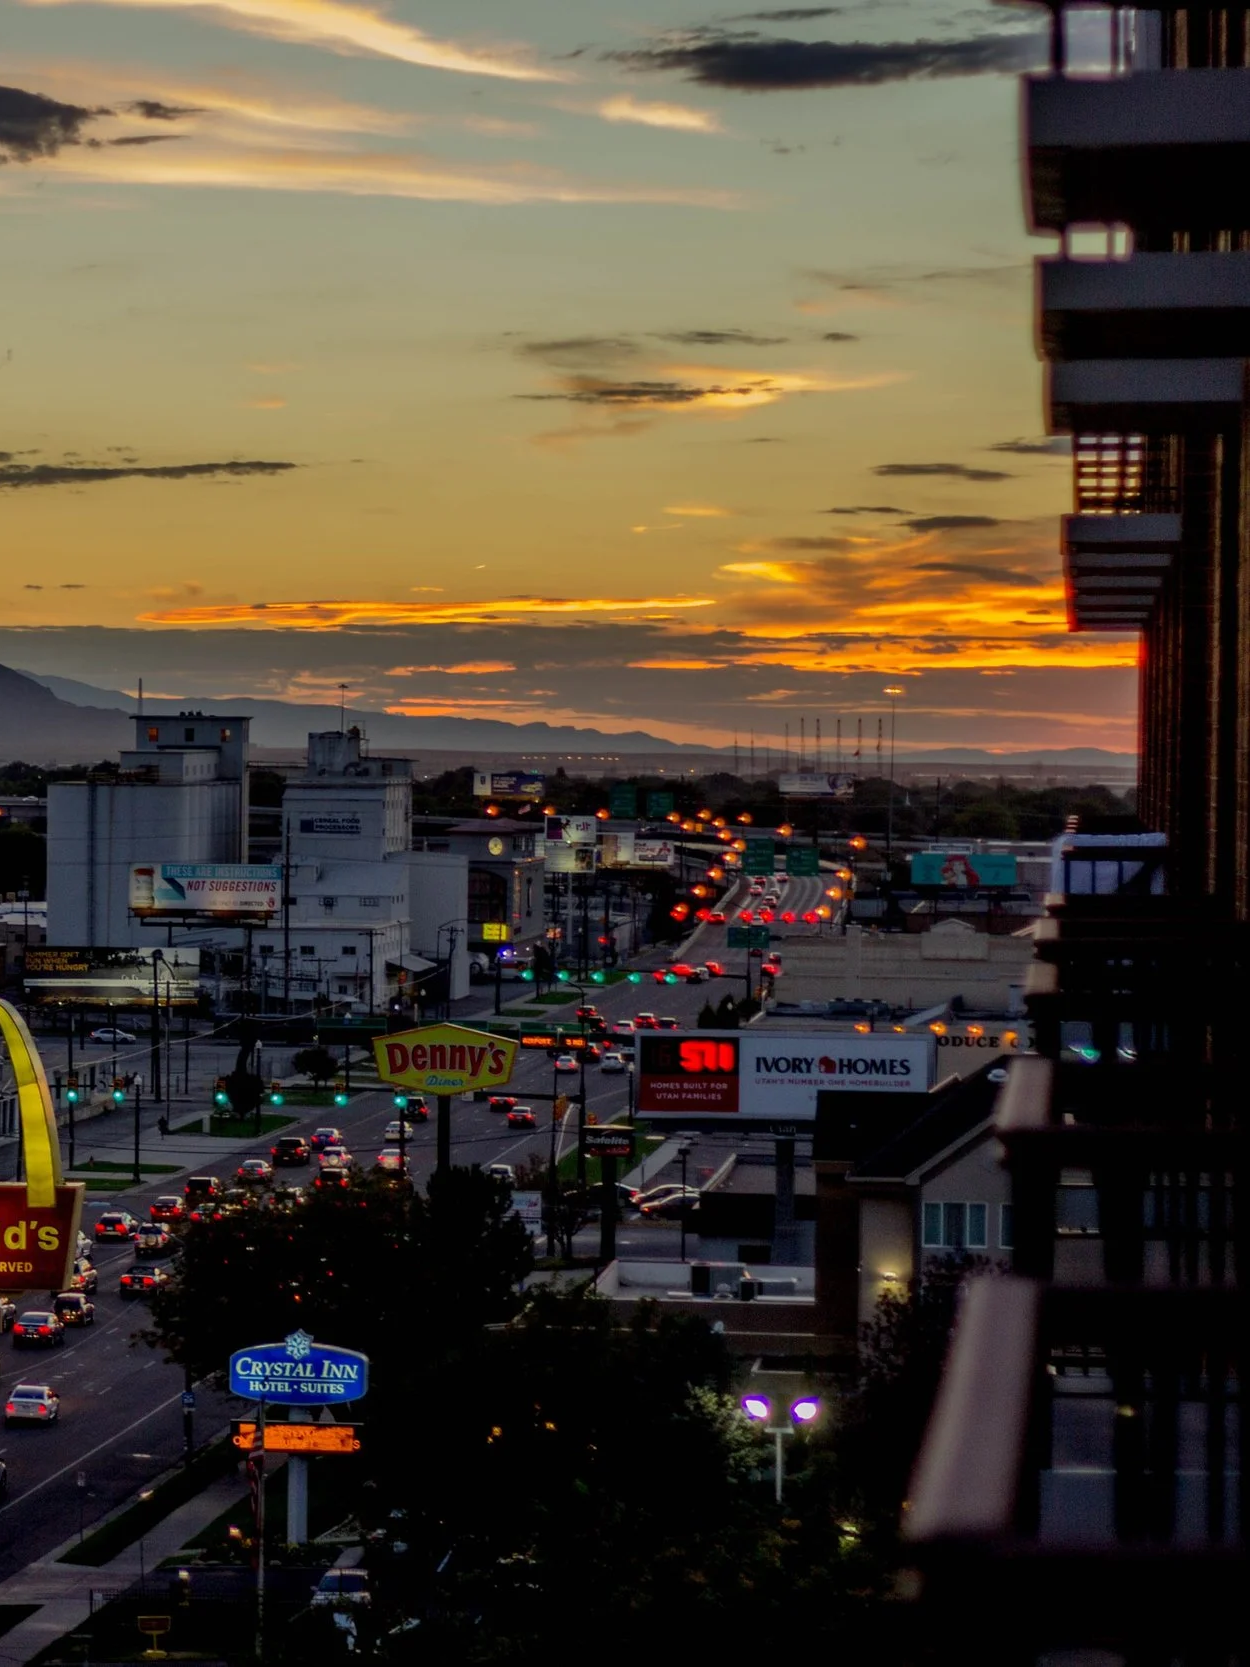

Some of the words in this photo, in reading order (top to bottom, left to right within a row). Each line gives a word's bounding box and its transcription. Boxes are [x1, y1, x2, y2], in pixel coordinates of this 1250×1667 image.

[166, 865, 193, 877] THESE
[195, 866, 212, 877] ARE
[215, 866, 277, 878] INSTRUCTIONS
[186, 880, 206, 891] NOT
[208, 881, 277, 892] SUGGESTIONS
[55, 963, 89, 972] HUNGRY
[385, 1042, 506, 1077] Denny's
[755, 1056, 815, 1073] IVORY
[838, 1058, 911, 1075] HOMES
[425, 1075, 464, 1087] Diner
[710, 1082, 728, 1090] FOR
[235, 1357, 316, 1378] CRYSTAL
[320, 1359, 359, 1379] INN
[250, 1382, 292, 1393] HOTEL
[300, 1383, 345, 1394] SUITES
